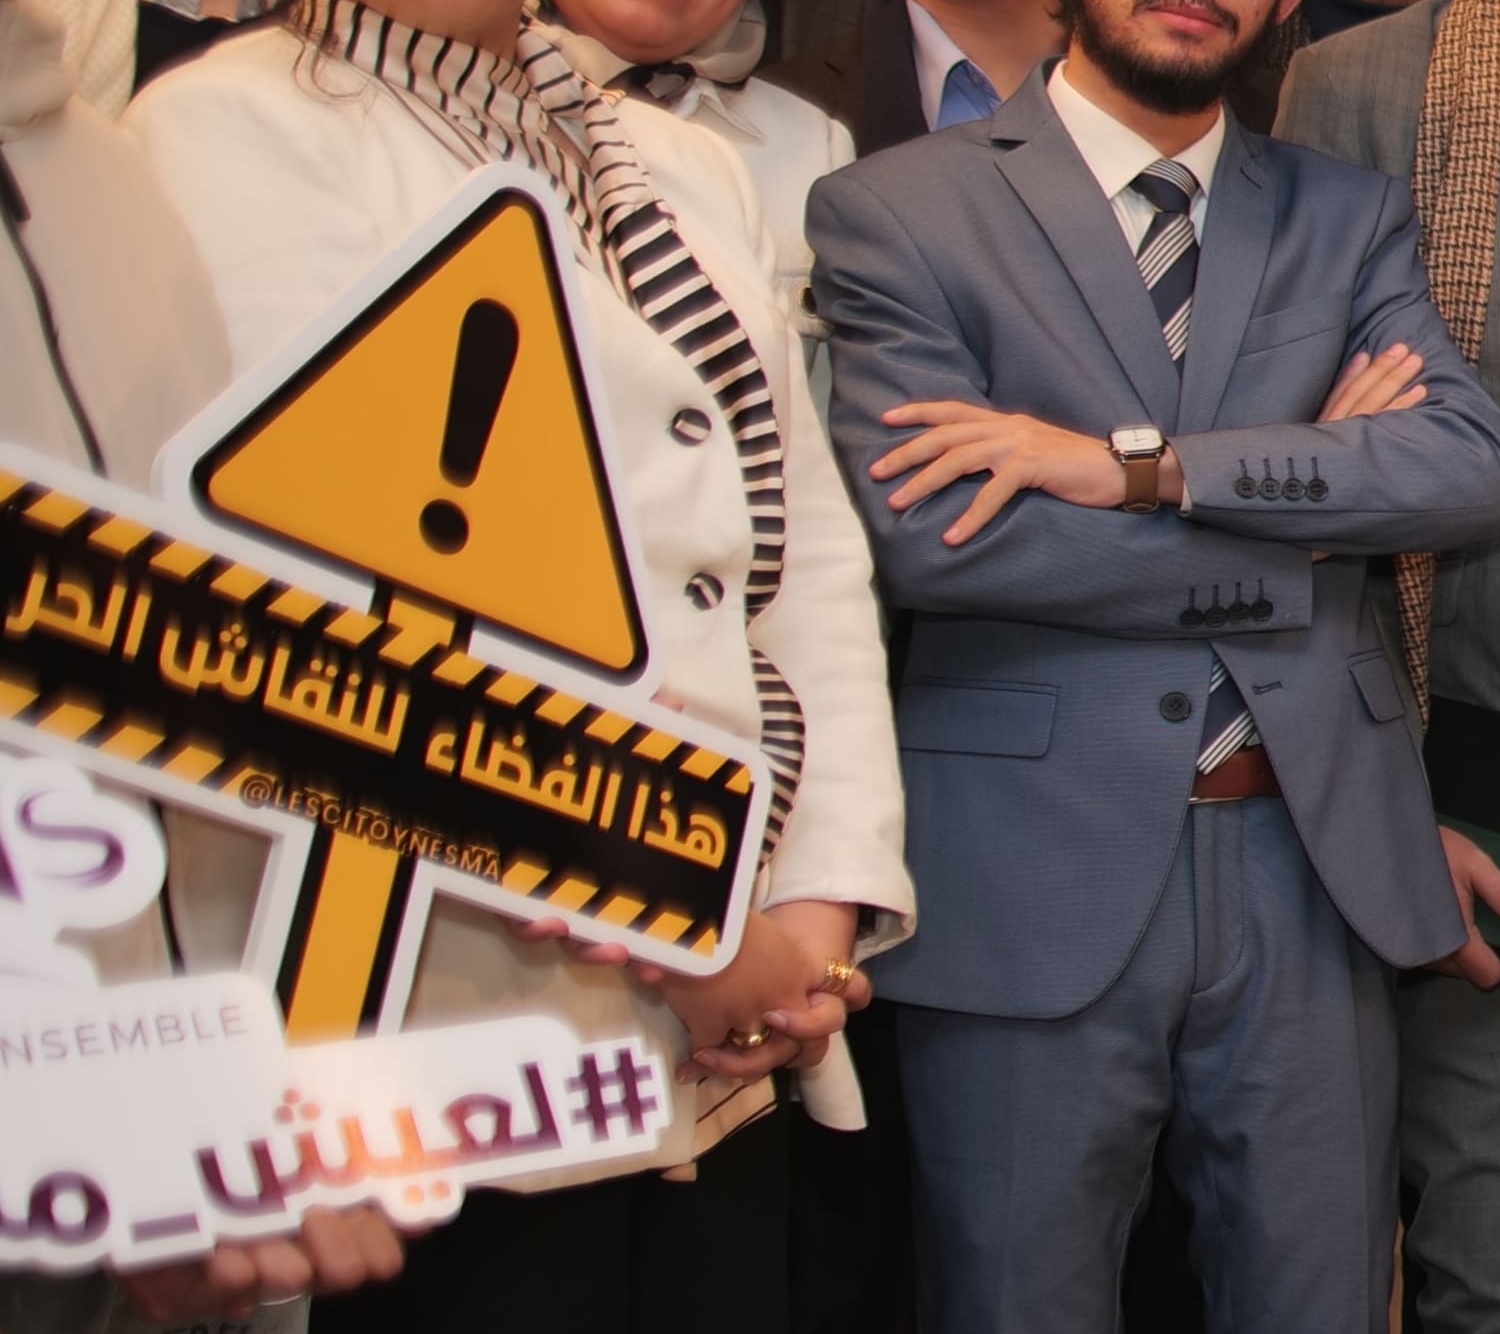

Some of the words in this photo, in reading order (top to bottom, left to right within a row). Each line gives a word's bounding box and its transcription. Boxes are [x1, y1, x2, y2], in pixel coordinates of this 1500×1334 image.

[4, 564, 152, 662] الحر
[157, 621, 411, 757] للنقاش
[423, 718, 623, 830] الفضاء
[242, 778, 501, 882] @LESCITOYNESMA
[626, 779, 729, 872] هذا
[0, 1004, 249, 1069] NSEMBLE
